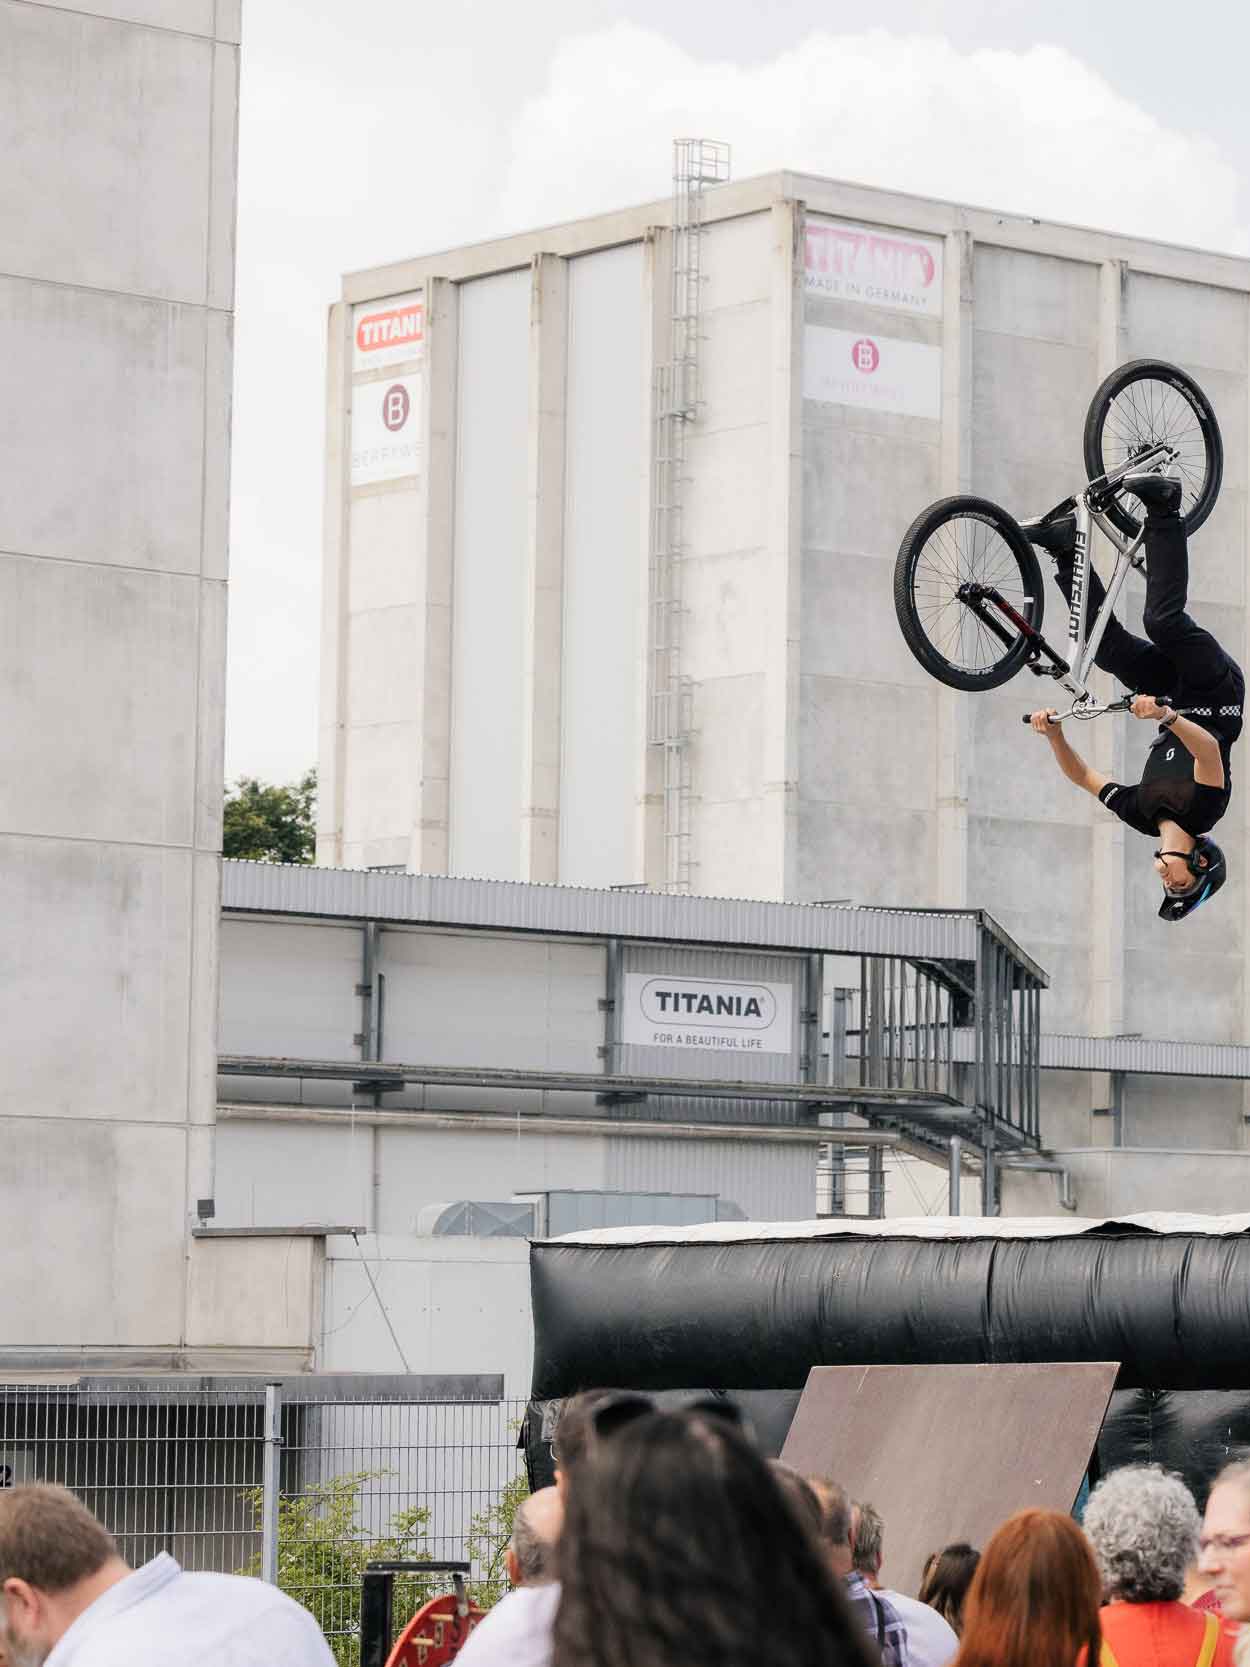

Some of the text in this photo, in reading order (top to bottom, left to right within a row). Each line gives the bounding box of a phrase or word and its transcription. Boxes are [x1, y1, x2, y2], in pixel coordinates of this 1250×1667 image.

[804, 275, 928, 306] MADE IN GERMANY
[653, 1033, 763, 1049] FOR A BEAUTIFUL LIFE
